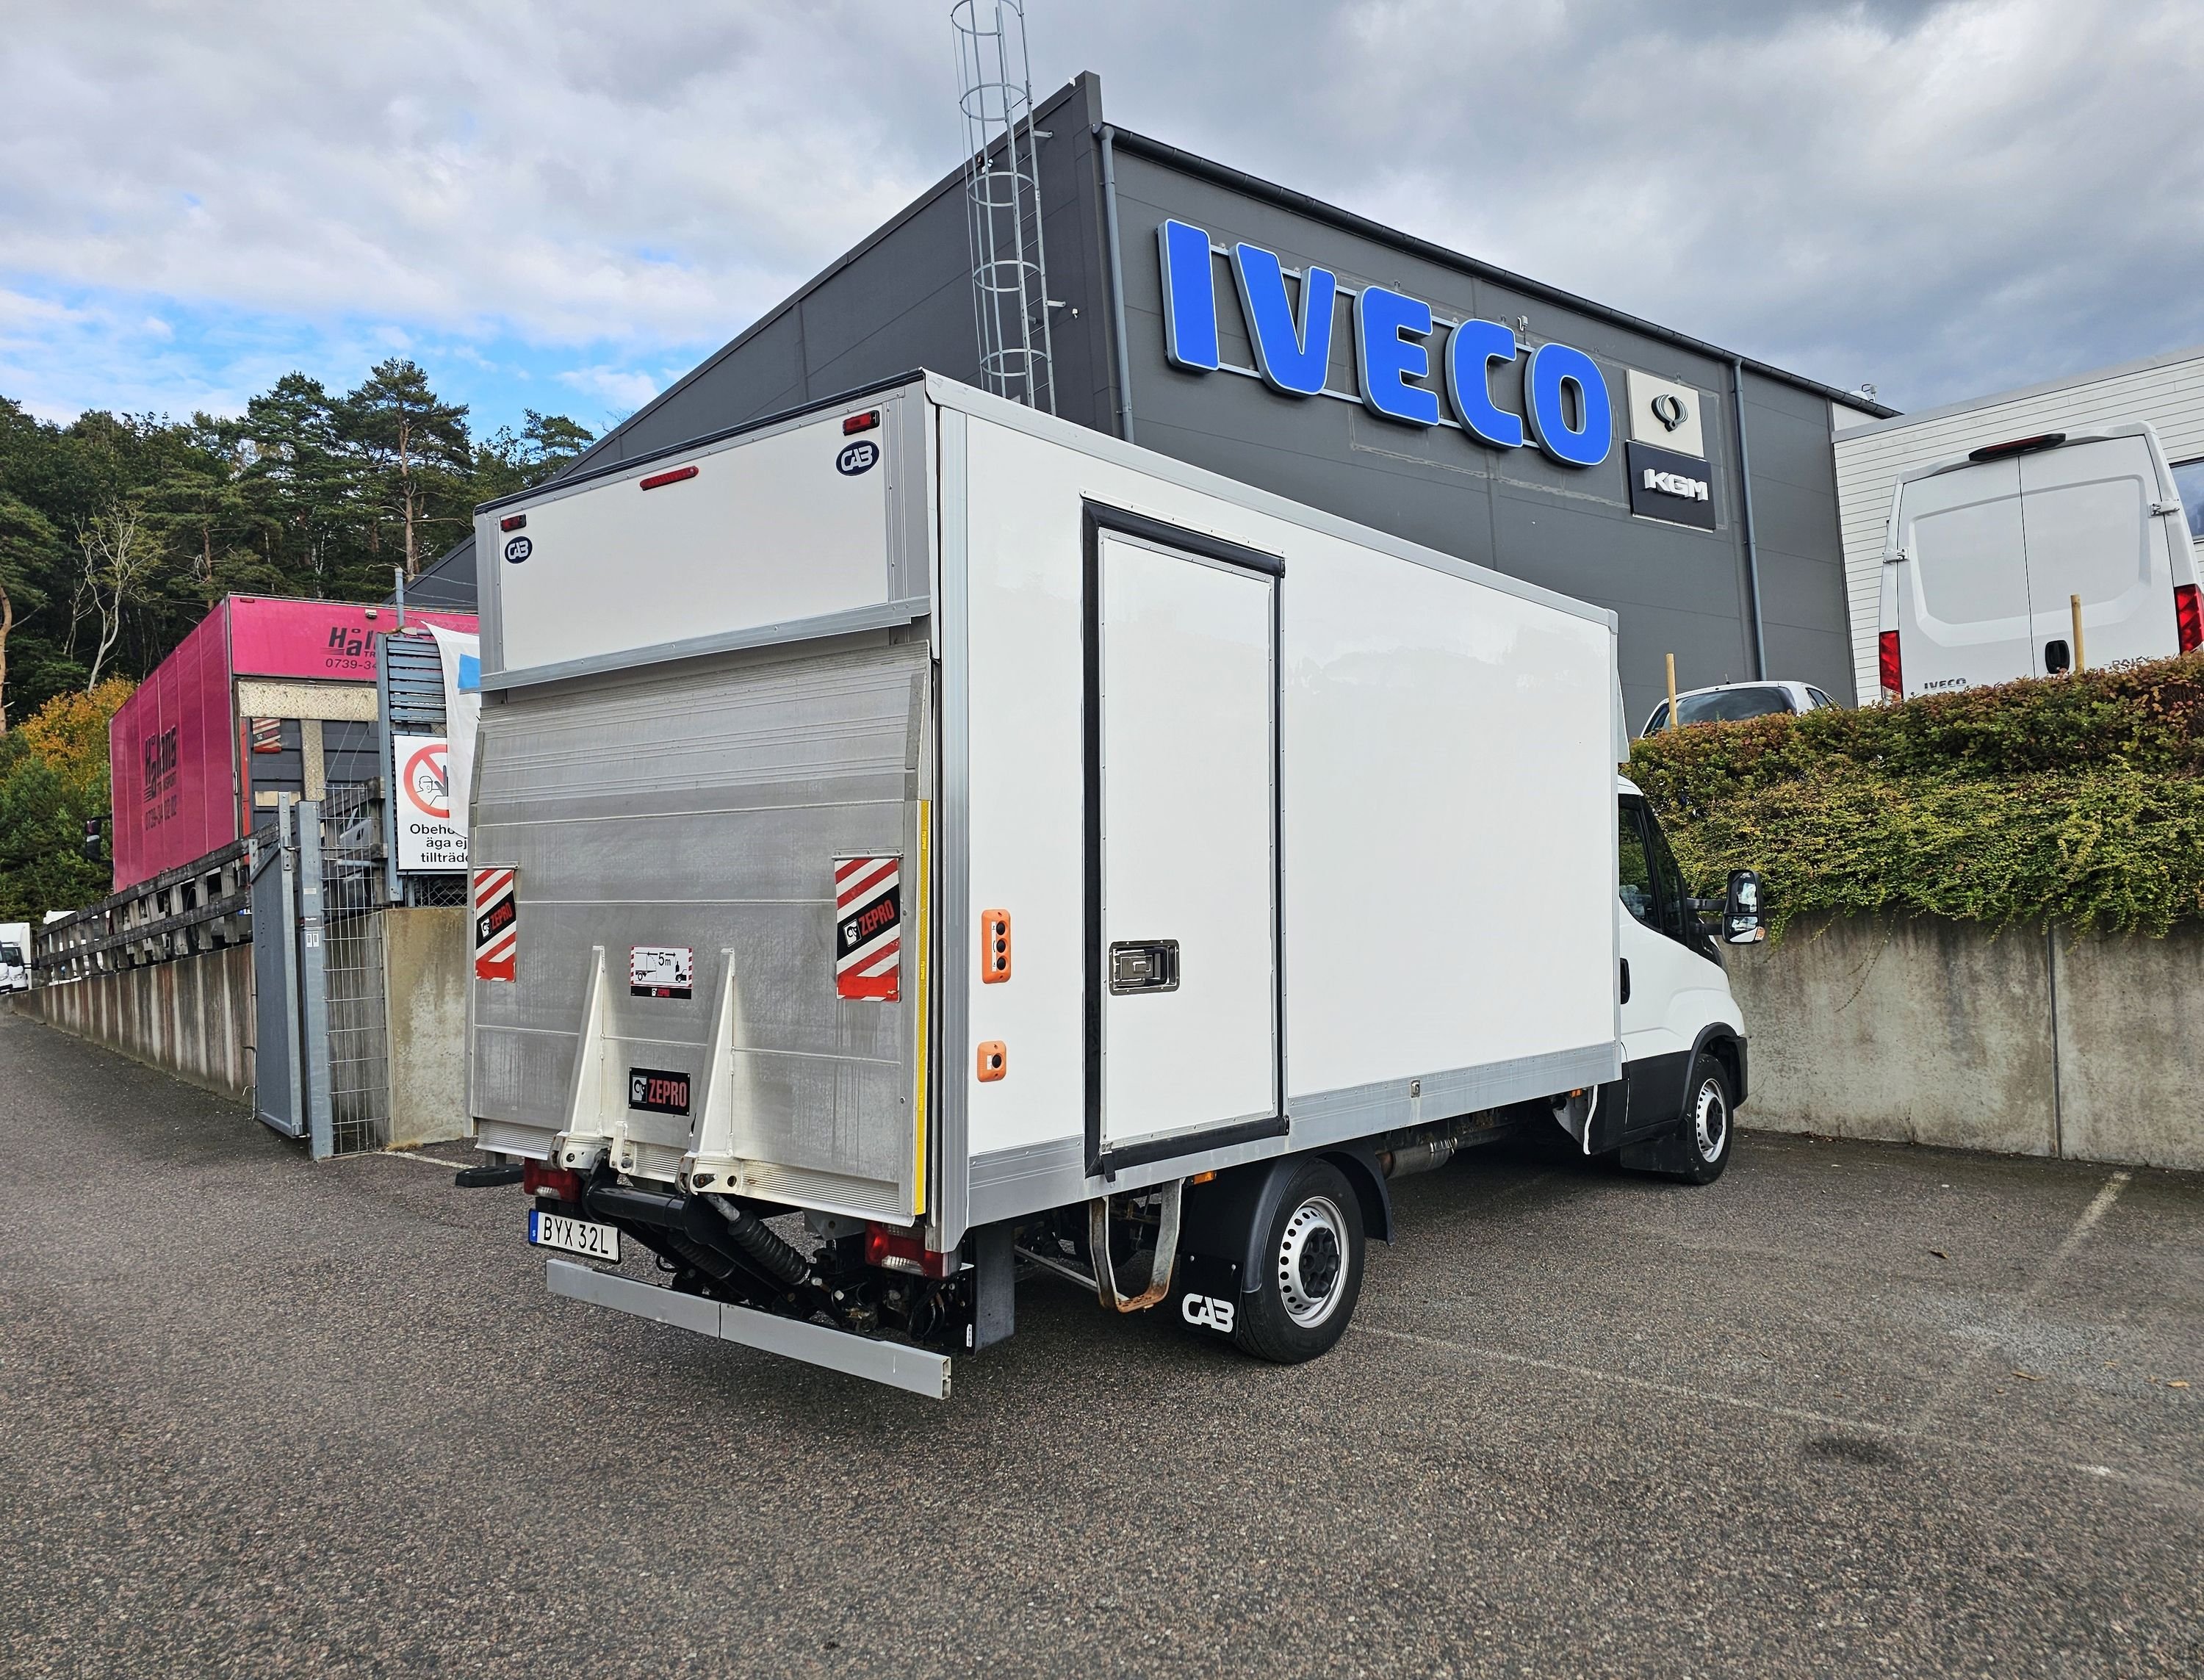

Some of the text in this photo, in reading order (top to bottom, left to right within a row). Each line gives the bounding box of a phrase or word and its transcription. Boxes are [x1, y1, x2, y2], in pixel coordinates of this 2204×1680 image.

[1158, 218, 1613, 467] IVECO
[840, 444, 873, 472] CAB
[1643, 468, 1709, 500] KGM
[508, 540, 529, 560] CAB
[1923, 677, 1967, 691] IVECO
[426, 837, 467, 850] äga ej
[489, 902, 513, 930] ZEPRO
[858, 899, 895, 937] ZEPRO
[648, 1078, 687, 1108] ZEPRO
[544, 1216, 608, 1255] BYX 32L
[1182, 1293, 1234, 1333] CAB
